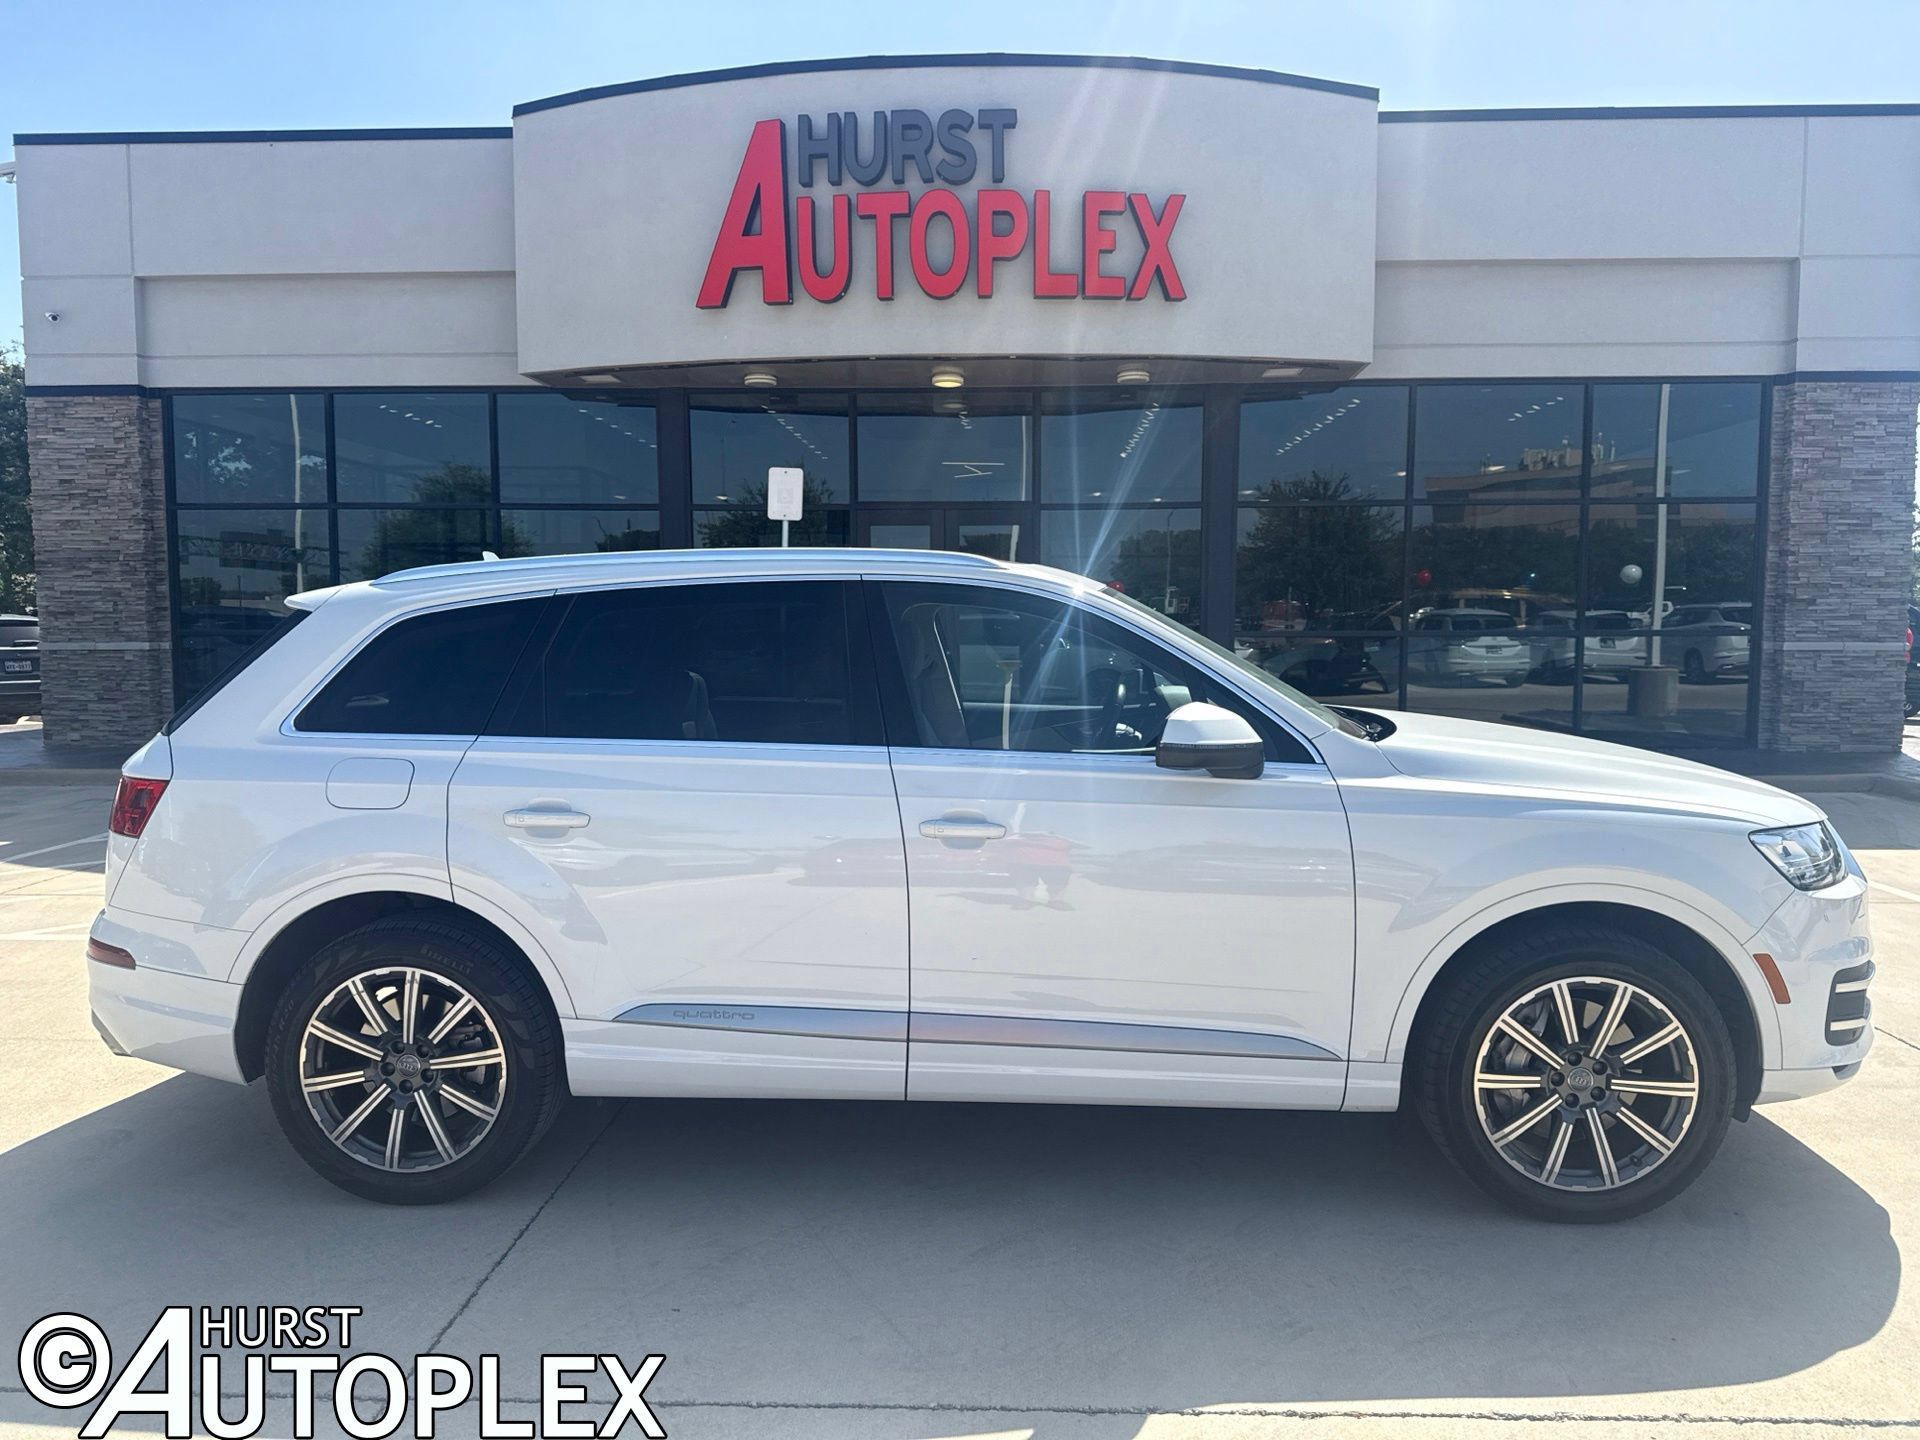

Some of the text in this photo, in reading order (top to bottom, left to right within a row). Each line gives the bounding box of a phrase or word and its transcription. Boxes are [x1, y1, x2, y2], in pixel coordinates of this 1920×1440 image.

[798, 108, 1017, 188] HURST
[696, 118, 1187, 309] AUTOPLEX
[673, 1009, 756, 1020] quattro
